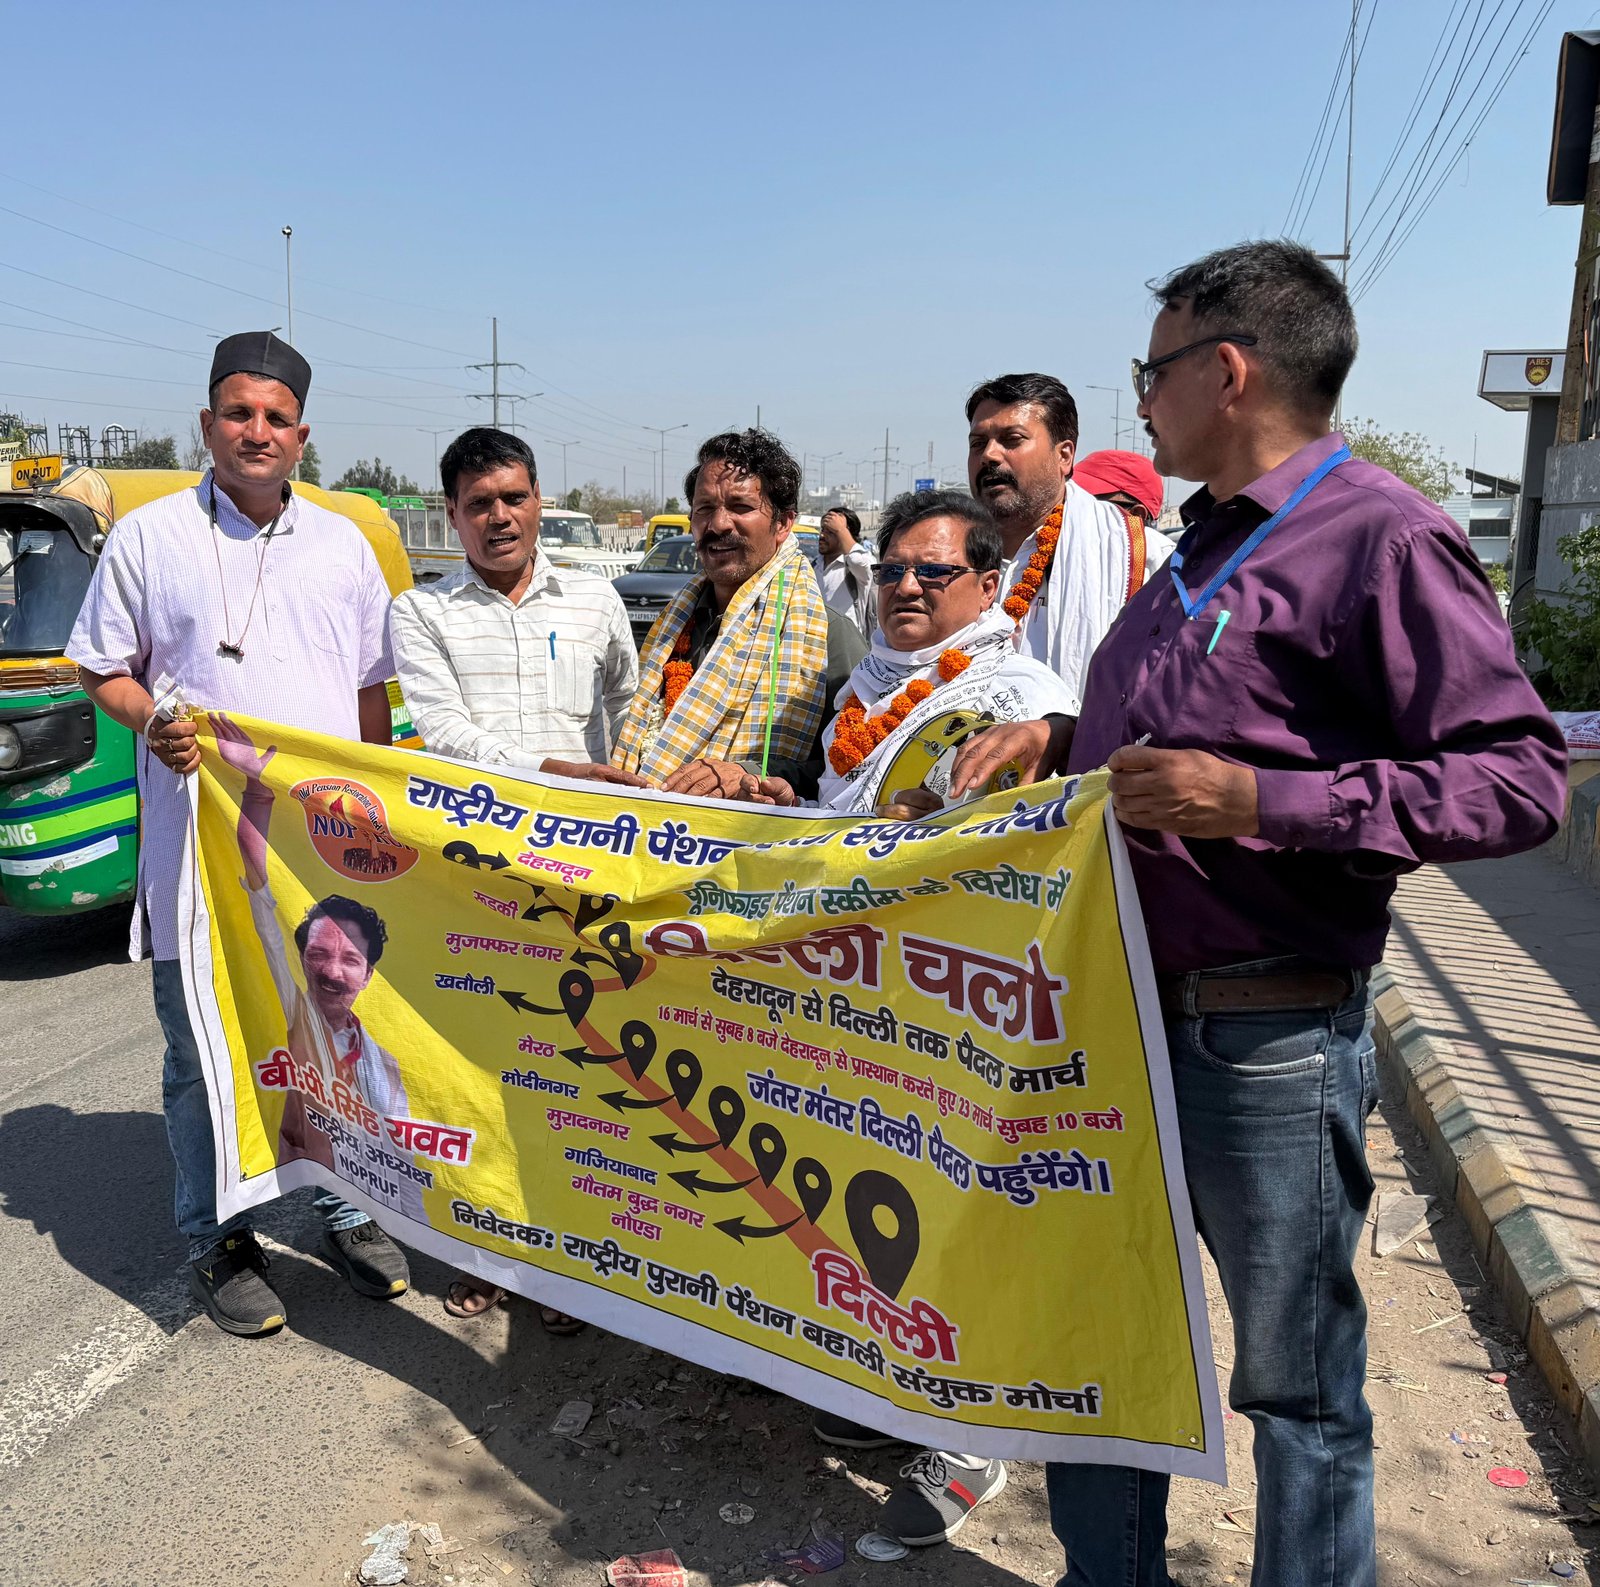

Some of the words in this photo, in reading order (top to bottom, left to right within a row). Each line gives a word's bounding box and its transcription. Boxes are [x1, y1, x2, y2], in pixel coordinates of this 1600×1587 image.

[16, 469, 30, 481] ON
[33, 466, 58, 479] DUTY
[299, 785, 311, 801] Old
[312, 783, 341, 794] Pension
[342, 783, 372, 809] Restoration
[367, 805, 382, 831] United
[408, 776, 528, 831] राष्ट्रीय
[527, 813, 640, 855] पुरानी
[517, 852, 593, 884] देहरादून
[821, 877, 906, 915] स्कीम
[907, 878, 950, 896] के
[952, 863, 1041, 906] विरोध
[1046, 869, 1071, 913] में
[445, 932, 520, 956] मुजफ्फर
[522, 945, 565, 963] नगर
[435, 972, 496, 995] खतौली
[902, 936, 1062, 1041] चलो
[518, 1035, 557, 1058] मेरठ
[710, 966, 796, 1024] देहरादून
[801, 988, 824, 1022] से
[828, 993, 898, 1044] दिल्ली
[903, 1023, 950, 1059] तक
[956, 1031, 1004, 1089] पैदल
[1008, 1050, 1086, 1093] मार्च
[501, 1068, 580, 1100] मोदीनगर
[658, 1005, 670, 1021] 16
[673, 1007, 698, 1027] मार्च
[700, 1010, 713, 1031] से
[715, 1018, 744, 1044] सुबह
[746, 1027, 754, 1043] 8
[757, 1029, 778, 1051] बजे
[781, 1034, 831, 1071] देहरादून
[834, 1048, 848, 1070] से
[902, 1075, 935, 1101] करते
[937, 1086, 957, 1117] हुए
[958, 1096, 970, 1118] 23
[972, 1104, 994, 1133] मार्च
[996, 1116, 1048, 1144] सुबह
[1055, 1113, 1078, 1131] 10
[1081, 1106, 1124, 1131] बजे
[384, 1117, 472, 1162] रावत
[546, 1107, 631, 1141] मुरादनगर
[746, 1069, 801, 1113] जंतर
[804, 1084, 856, 1132] मंतर
[860, 1098, 923, 1160] दिल्ली
[928, 1125, 971, 1190] पैदल
[305, 1106, 360, 1152] राष्ट्रीय
[365, 1143, 433, 1189] अध्यक्ष
[564, 1146, 658, 1186] गाजियाबाद
[338, 1153, 399, 1198] NOPRUF
[571, 1173, 623, 1202] गौतम
[627, 1190, 660, 1214] बुद्ध
[663, 1200, 706, 1229] नगर
[611, 1210, 662, 1241] नोएडा
[563, 1234, 641, 1277] राष्ट्रीय
[646, 1261, 720, 1306] पुरानी
[726, 1285, 797, 1335] पेंशन
[802, 1319, 885, 1377] बहाली
[891, 1363, 994, 1408] संयुक्त
[1003, 1381, 1098, 1414] मोर्चा
[812, 1252, 957, 1362] दिल्ली
